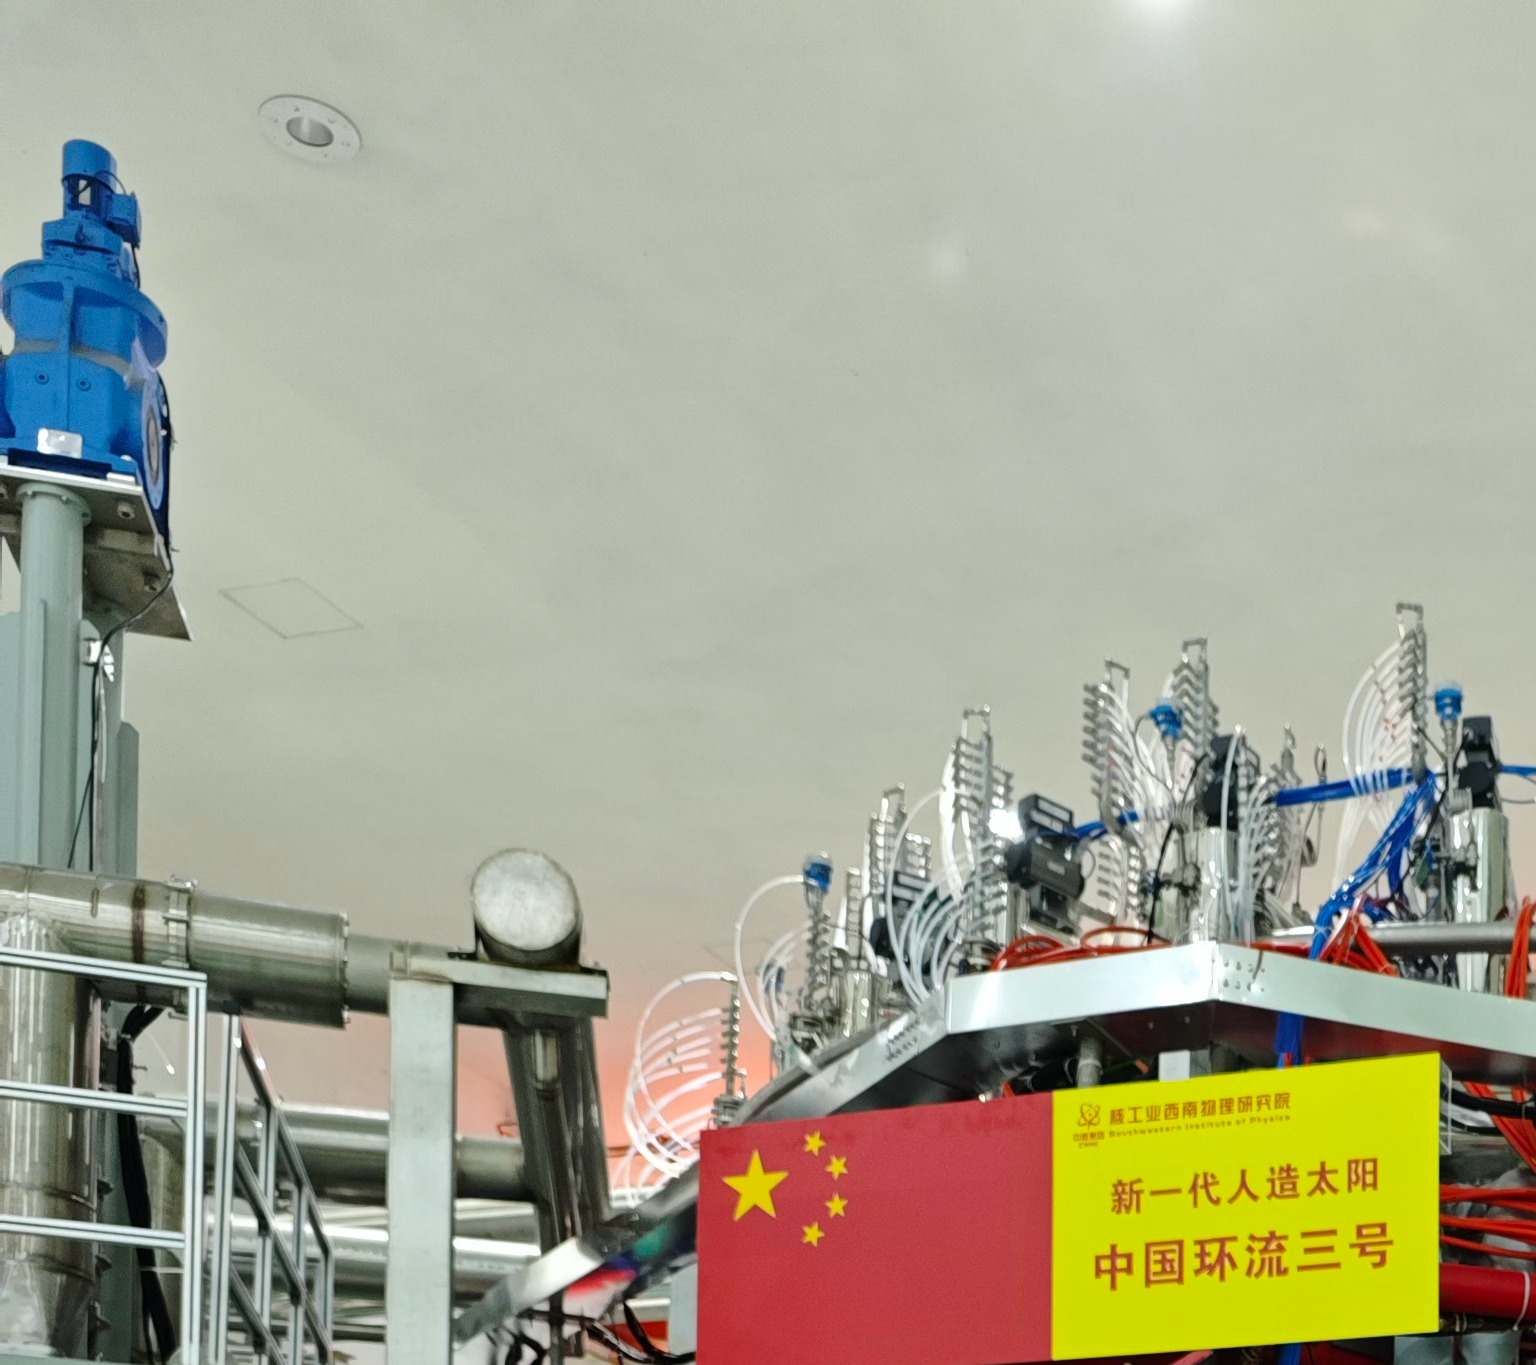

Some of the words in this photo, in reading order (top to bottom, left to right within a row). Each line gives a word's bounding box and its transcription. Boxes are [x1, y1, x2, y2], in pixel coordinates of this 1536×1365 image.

[1109, 1092, 1291, 1126] 核工业西南物理研究院
[1185, 1120, 1232, 1131] Institute
[1235, 1117, 1246, 1127] of
[1250, 1114, 1291, 1126] Physics
[1111, 1157, 1379, 1215] 新一代人造太阳
[1094, 1222, 1394, 1292] 中国环流三号
